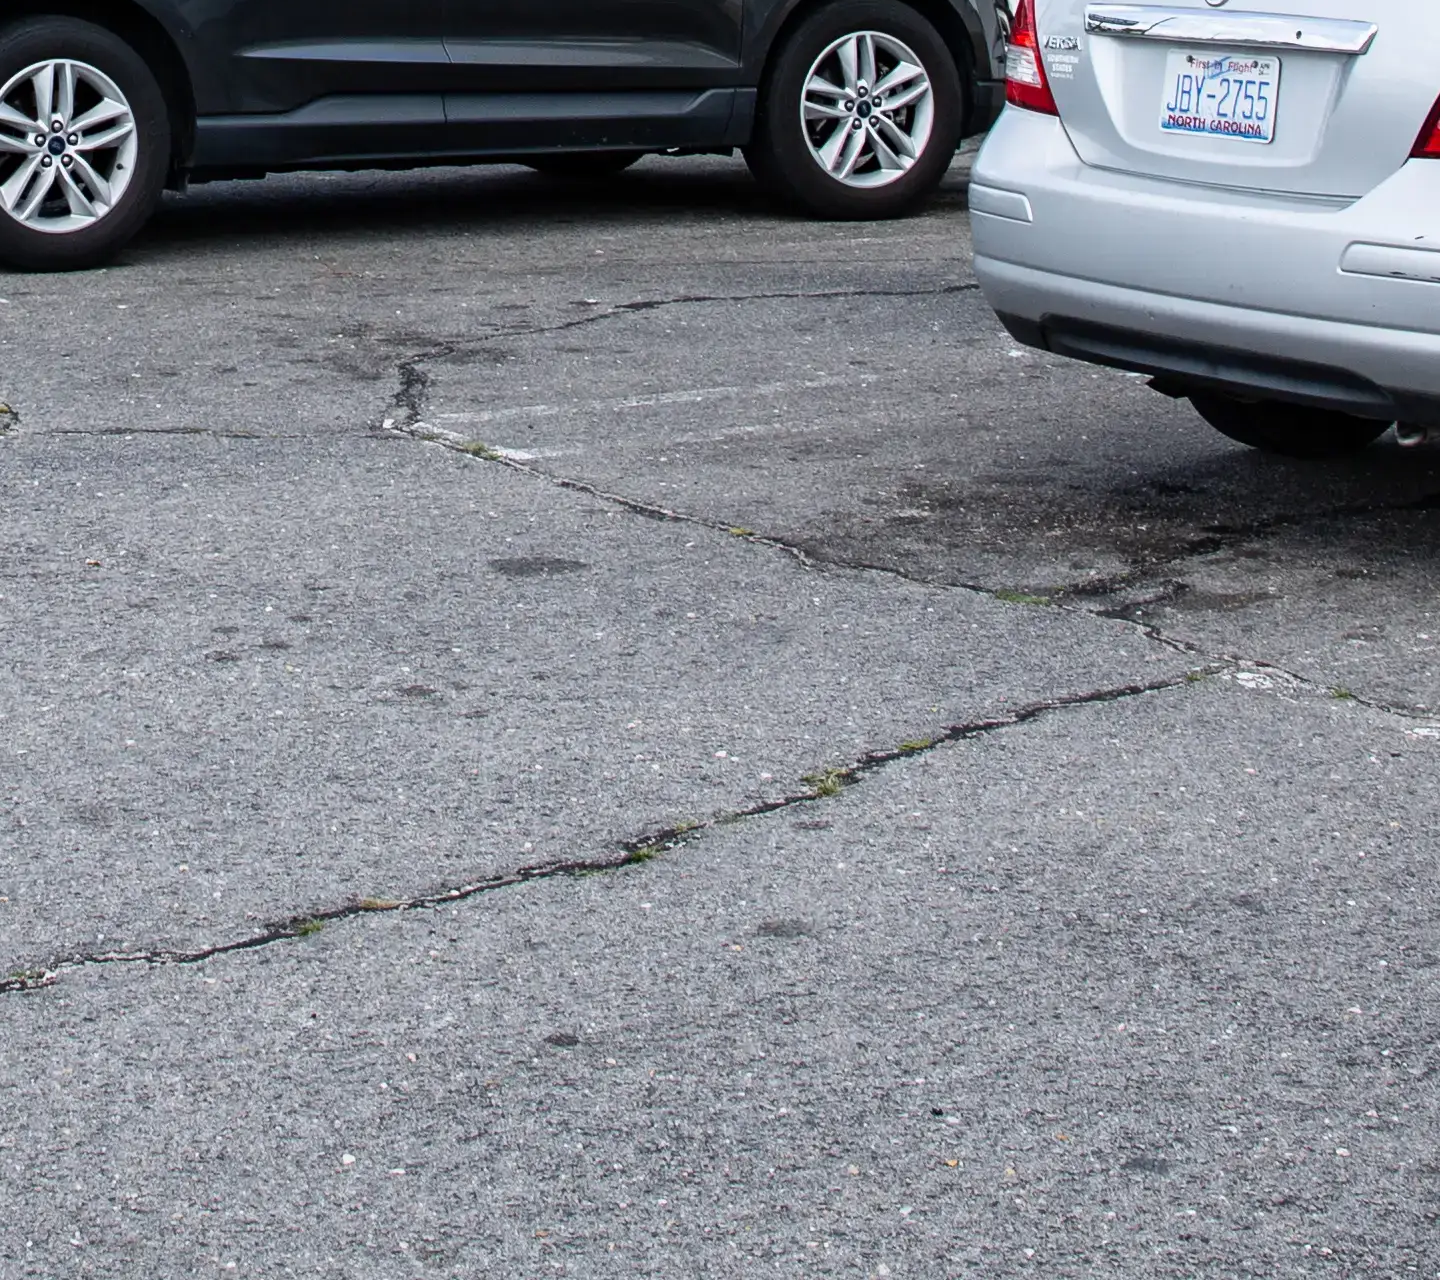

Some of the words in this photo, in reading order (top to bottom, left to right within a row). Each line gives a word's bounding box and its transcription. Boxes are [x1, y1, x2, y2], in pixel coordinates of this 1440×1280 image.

[1227, 60, 1254, 75] Flight
[1166, 73, 1270, 121] JBY-2755
[1167, 114, 1206, 130] NORTH
[1209, 119, 1262, 136] CAROLINA
